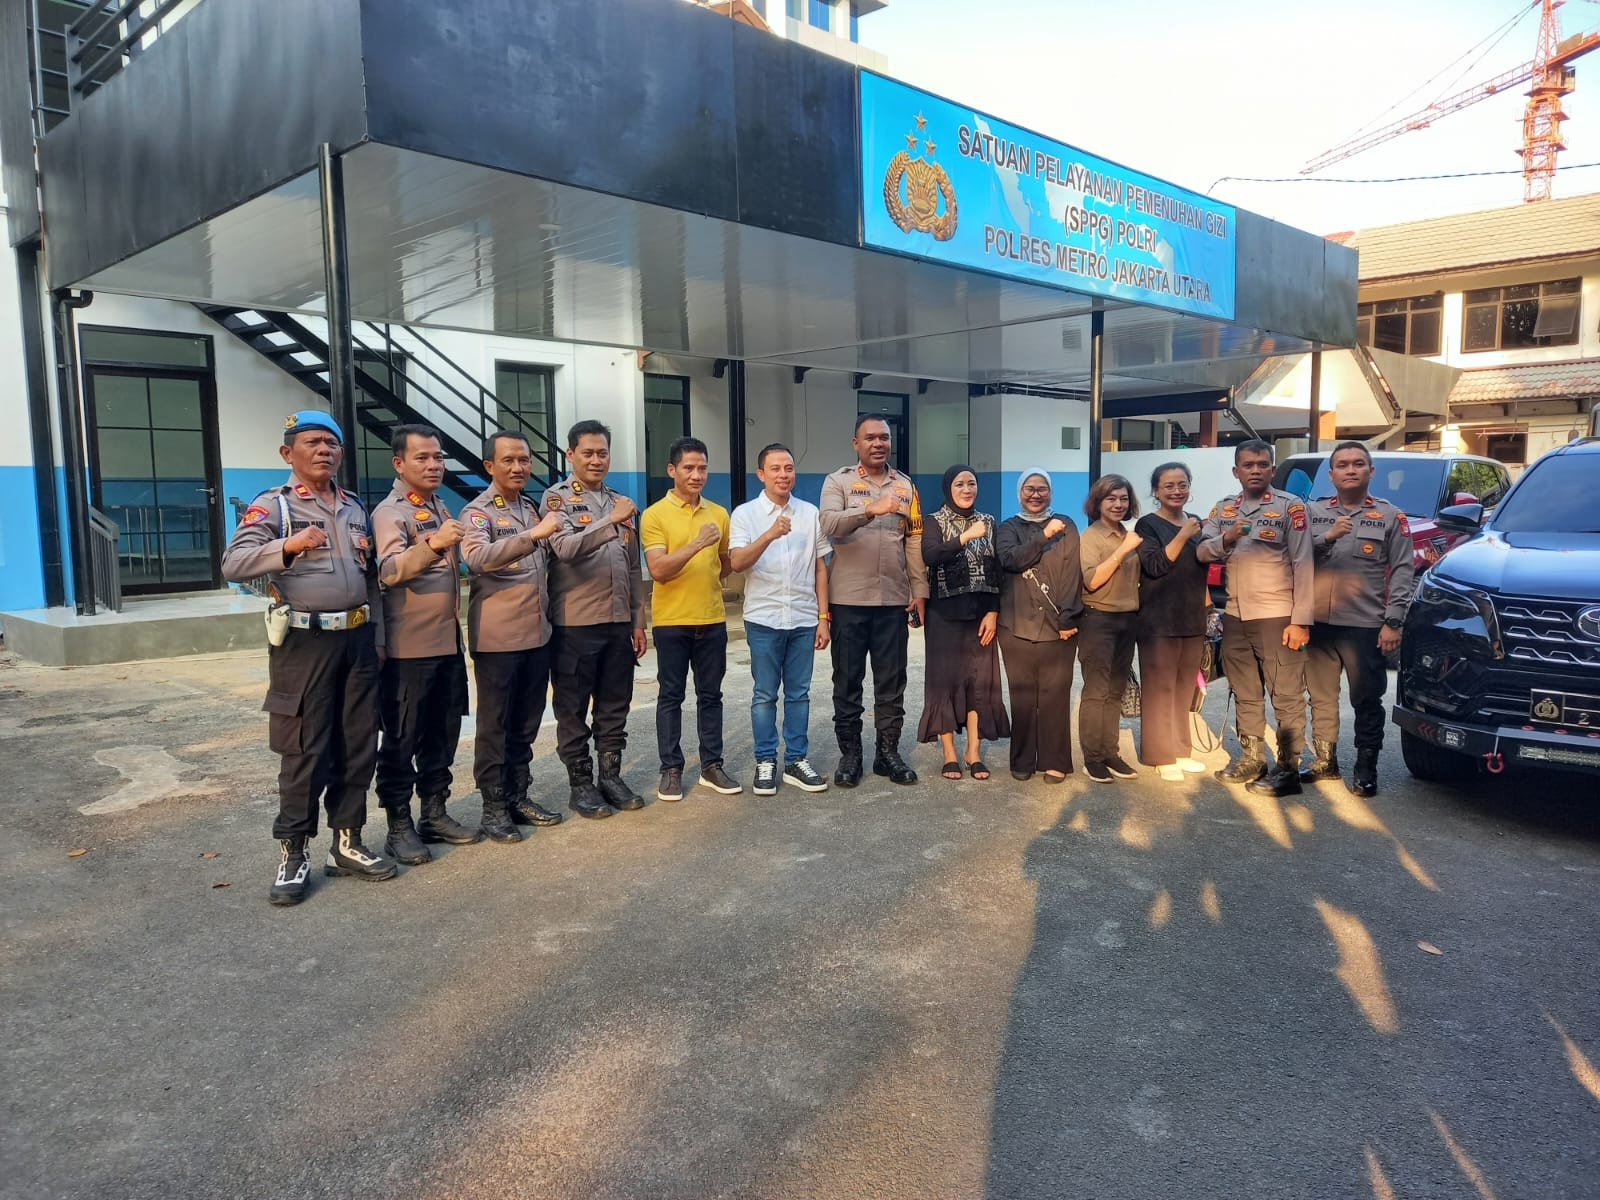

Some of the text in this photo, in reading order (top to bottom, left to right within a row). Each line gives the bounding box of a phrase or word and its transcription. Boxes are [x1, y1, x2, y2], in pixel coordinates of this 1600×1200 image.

[958, 125, 1226, 238] SATUAN PELAYANAN PEMENUHAN GIZI
[1065, 205, 1156, 253] (SPPG) POLRI
[984, 225, 1211, 302] POLRES METRO JAKARTA UTARA
[850, 489, 871, 497] JAMES
[1256, 519, 1285, 529] POLRI
[1360, 519, 1386, 529] POLRI
[496, 527, 519, 537] ZUHRI
[1577, 712, 1590, 725] 2
